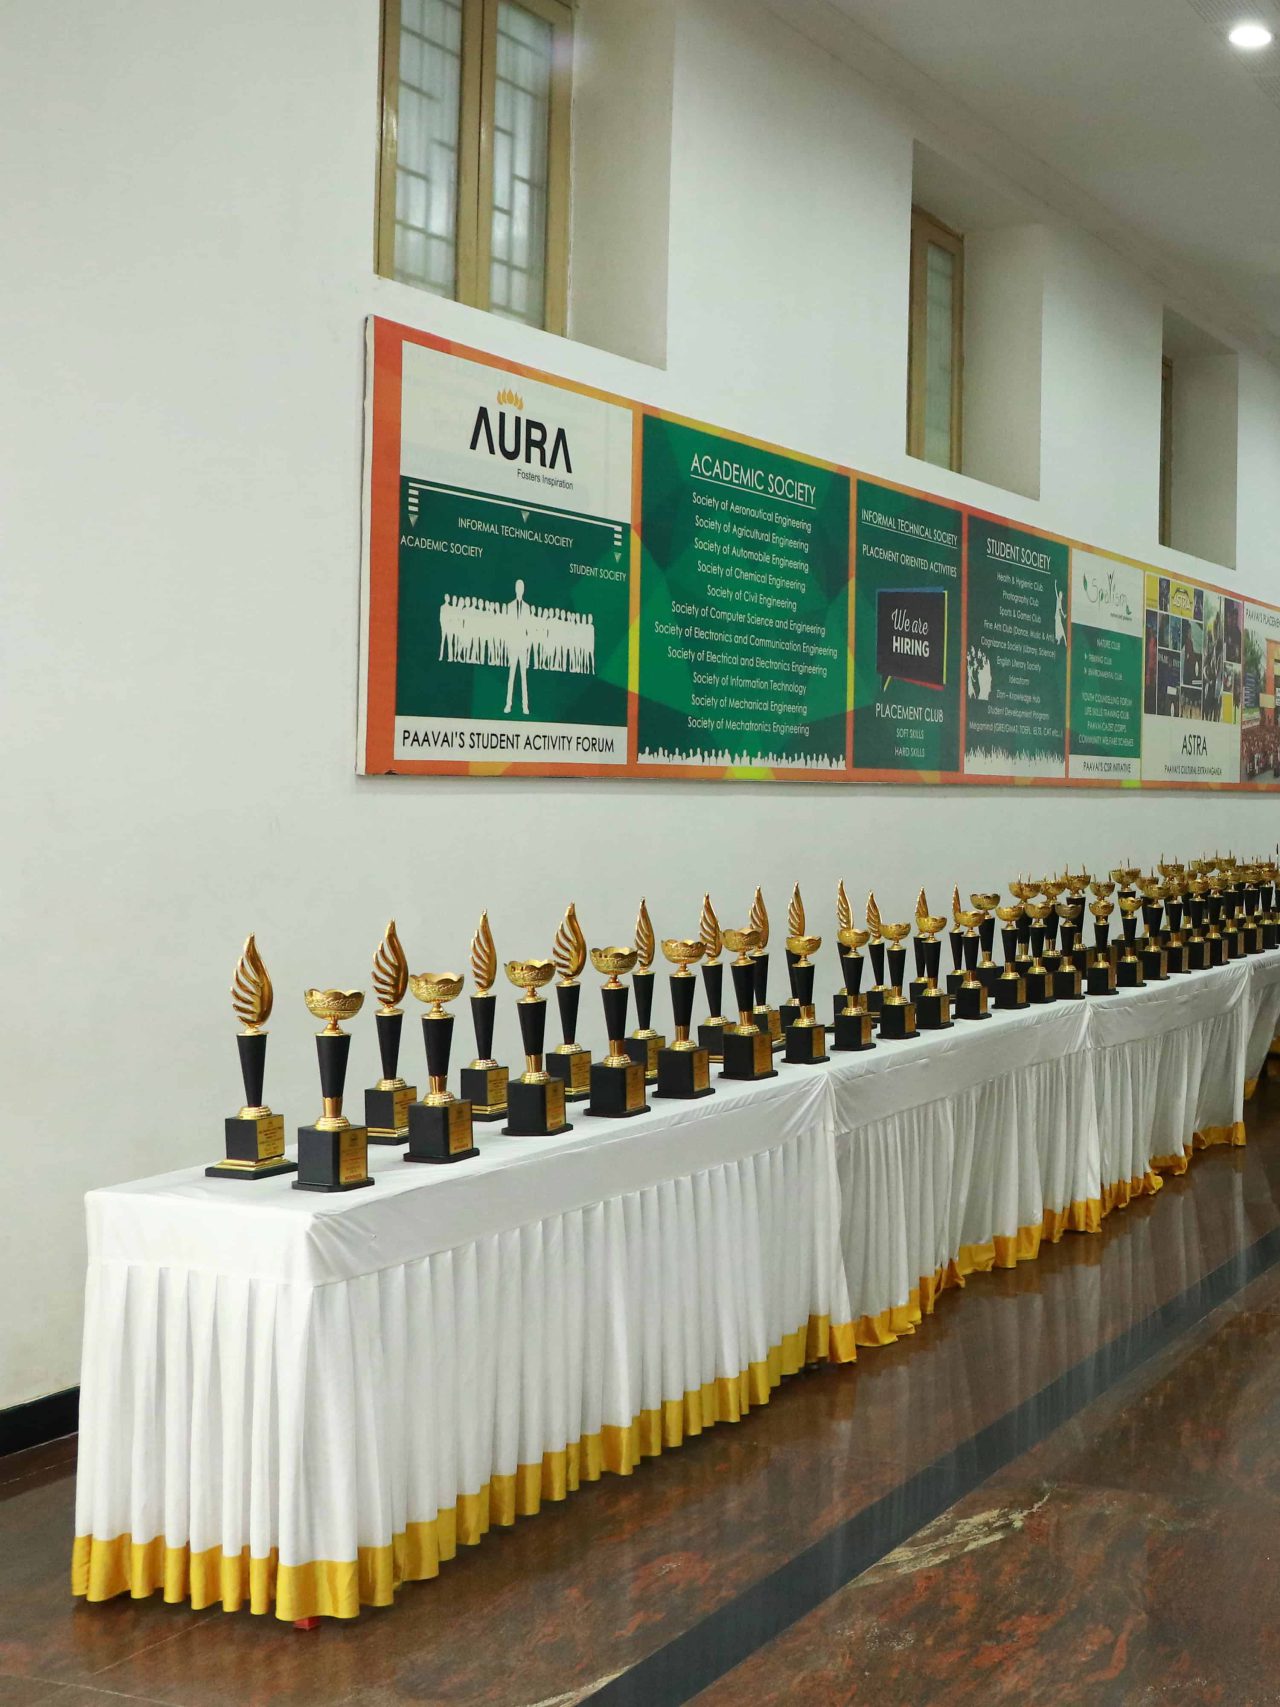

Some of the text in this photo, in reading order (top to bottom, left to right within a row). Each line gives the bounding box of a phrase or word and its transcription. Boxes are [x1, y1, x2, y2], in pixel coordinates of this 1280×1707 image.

[469, 406, 573, 474] AURA
[517, 468, 574, 490] Fosters Inspiration
[691, 453, 816, 504] ACADEMIC SOCIETY
[693, 492, 812, 534] Society of Aeronautical Engineering
[458, 517, 574, 548] INFORMAL TECHNICAL SOCIETY
[695, 515, 809, 553] Society of Agricultural Engineering
[862, 509, 957, 546] INFORMAL TECHNICAL SOCIETY
[400, 536, 483, 558] ACADEMIC SOCIETY
[694, 538, 809, 573] Society of Automobile Engineering
[987, 538, 1051, 570] STUDENT SOCIETY
[863, 544, 957, 578] PLACEMENT ORIENTED ACTIVITIES
[569, 564, 626, 582] STUDENT SOCIETY
[698, 561, 805, 594] Society of Chemical Engineering
[707, 585, 797, 612] Society of Civil Engineering
[1003, 591, 1039, 606] Photography Club
[1034, 582, 1044, 592] Club
[672, 601, 826, 637] Society of Computer Science and Engineering
[892, 608, 928, 635] We are
[984, 620, 992, 629] Fine
[1002, 624, 1012, 633] Club
[1032, 614, 1041, 623] Club
[655, 621, 837, 659] Society of Electronics and Communication Engineering
[892, 636, 929, 658] HIRING
[668, 646, 827, 678] Society of Electrical and Electronics Engineering
[693, 672, 806, 695] Society of Information Technology
[692, 694, 807, 716] Society of Mechanical Engineering
[876, 703, 944, 723] PLACEMENT CLUB
[688, 716, 810, 737] Society of Mechatronics Engineering
[896, 728, 924, 739] SOFT SKILLS
[402, 730, 615, 752] PAAVAI'S STUDENT ACTIVITY FORUM
[894, 746, 924, 758] HARD SKILLS
[1181, 734, 1207, 756] ASTRA
